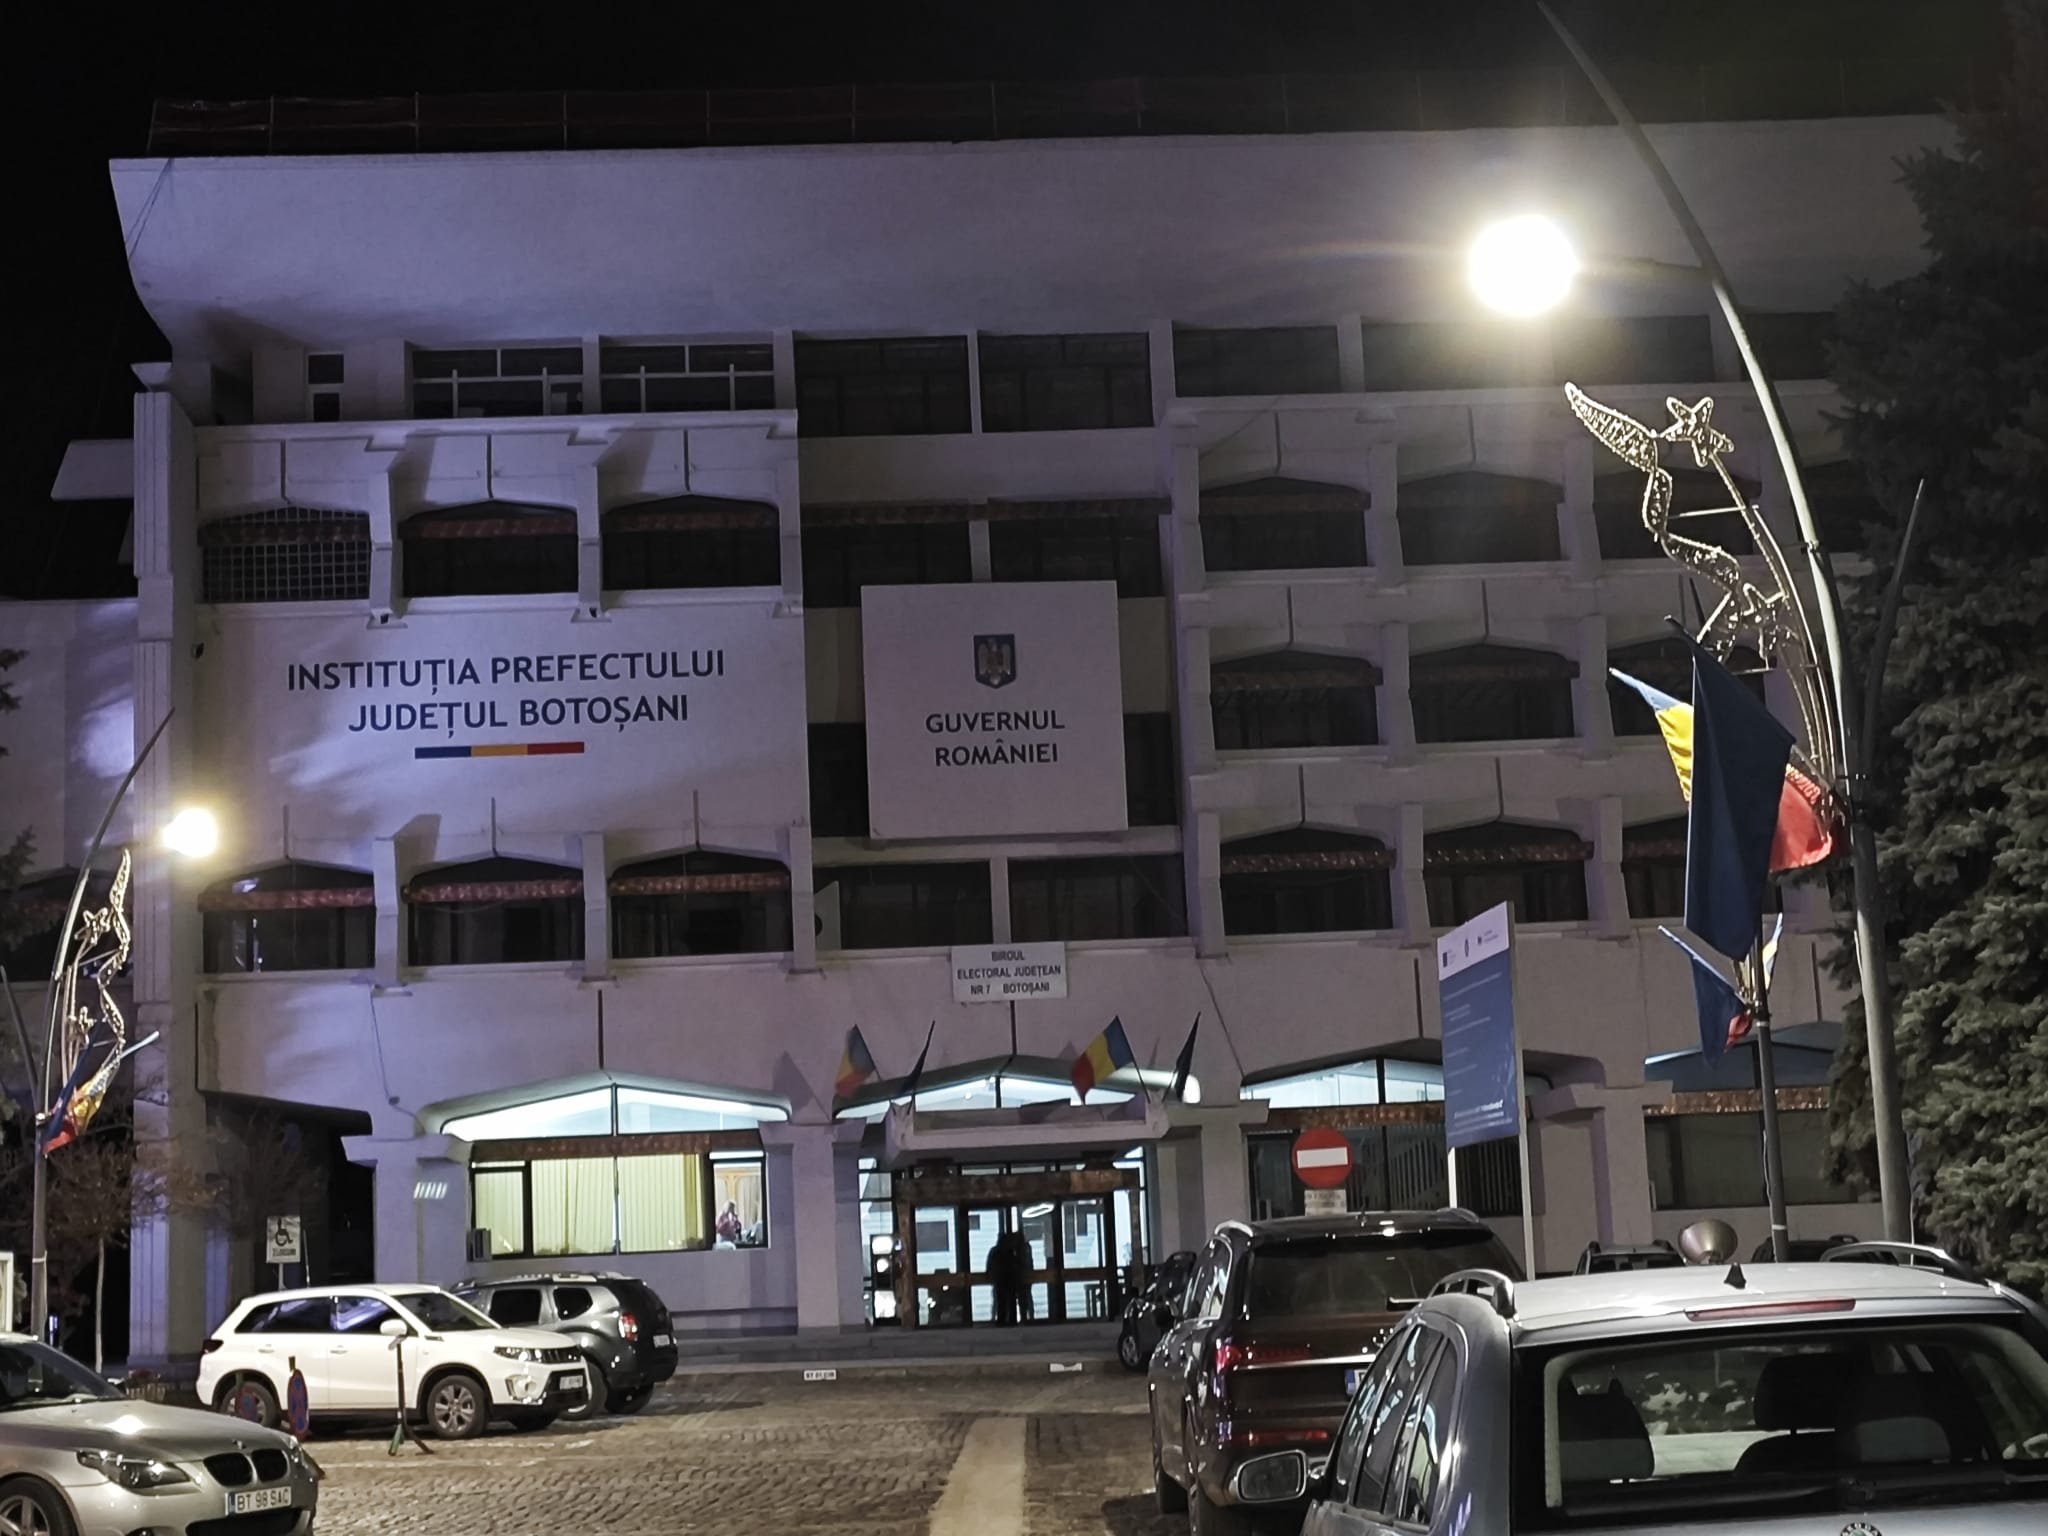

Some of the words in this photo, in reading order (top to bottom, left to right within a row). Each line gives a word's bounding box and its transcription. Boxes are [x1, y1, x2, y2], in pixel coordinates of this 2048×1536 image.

[287, 657, 480, 695] INSTITUȚIA
[491, 649, 725, 684] PREFECTULUI
[348, 701, 508, 738] JUDEȚUL
[519, 694, 689, 732] BOTOȘANI
[925, 710, 1065, 734] GUVERNUL
[935, 738, 1058, 767] ROMÂNIEI
[991, 950, 1025, 961] BIROUL
[957, 967, 1011, 979] ELECTORAL
[970, 985, 984, 995] NR
[1003, 982, 1050, 995] BOTOȘANI
[238, 1493, 250, 1511] BT
